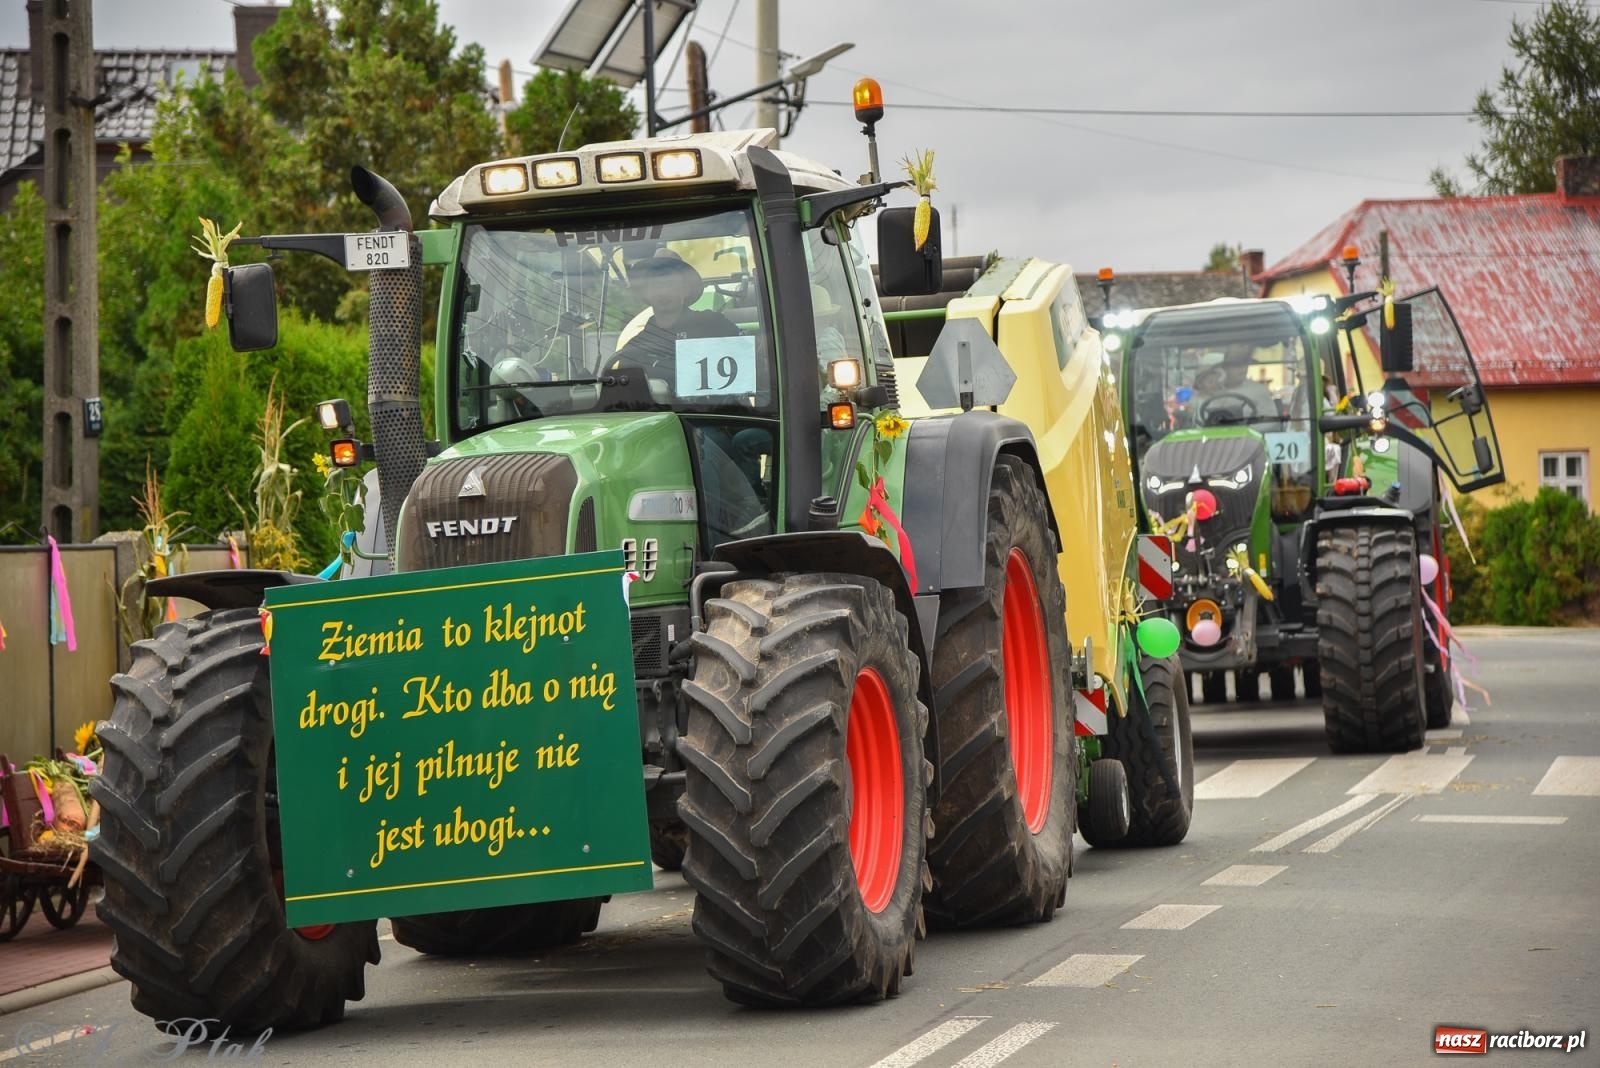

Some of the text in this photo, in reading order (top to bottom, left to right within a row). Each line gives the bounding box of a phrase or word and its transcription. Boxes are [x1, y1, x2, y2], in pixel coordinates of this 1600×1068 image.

[357, 235, 395, 250] FENDT
[366, 252, 389, 265] 820
[695, 355, 738, 391] 19
[1274, 441, 1299, 461] 20
[426, 515, 518, 538] FENDT
[318, 601, 586, 662] Ziemia to klejnot
[299, 662, 616, 739] drogi. Kto dba o nią
[338, 733, 580, 803] i jej pilnuje nie
[370, 805, 551, 869] jest ubogi...
